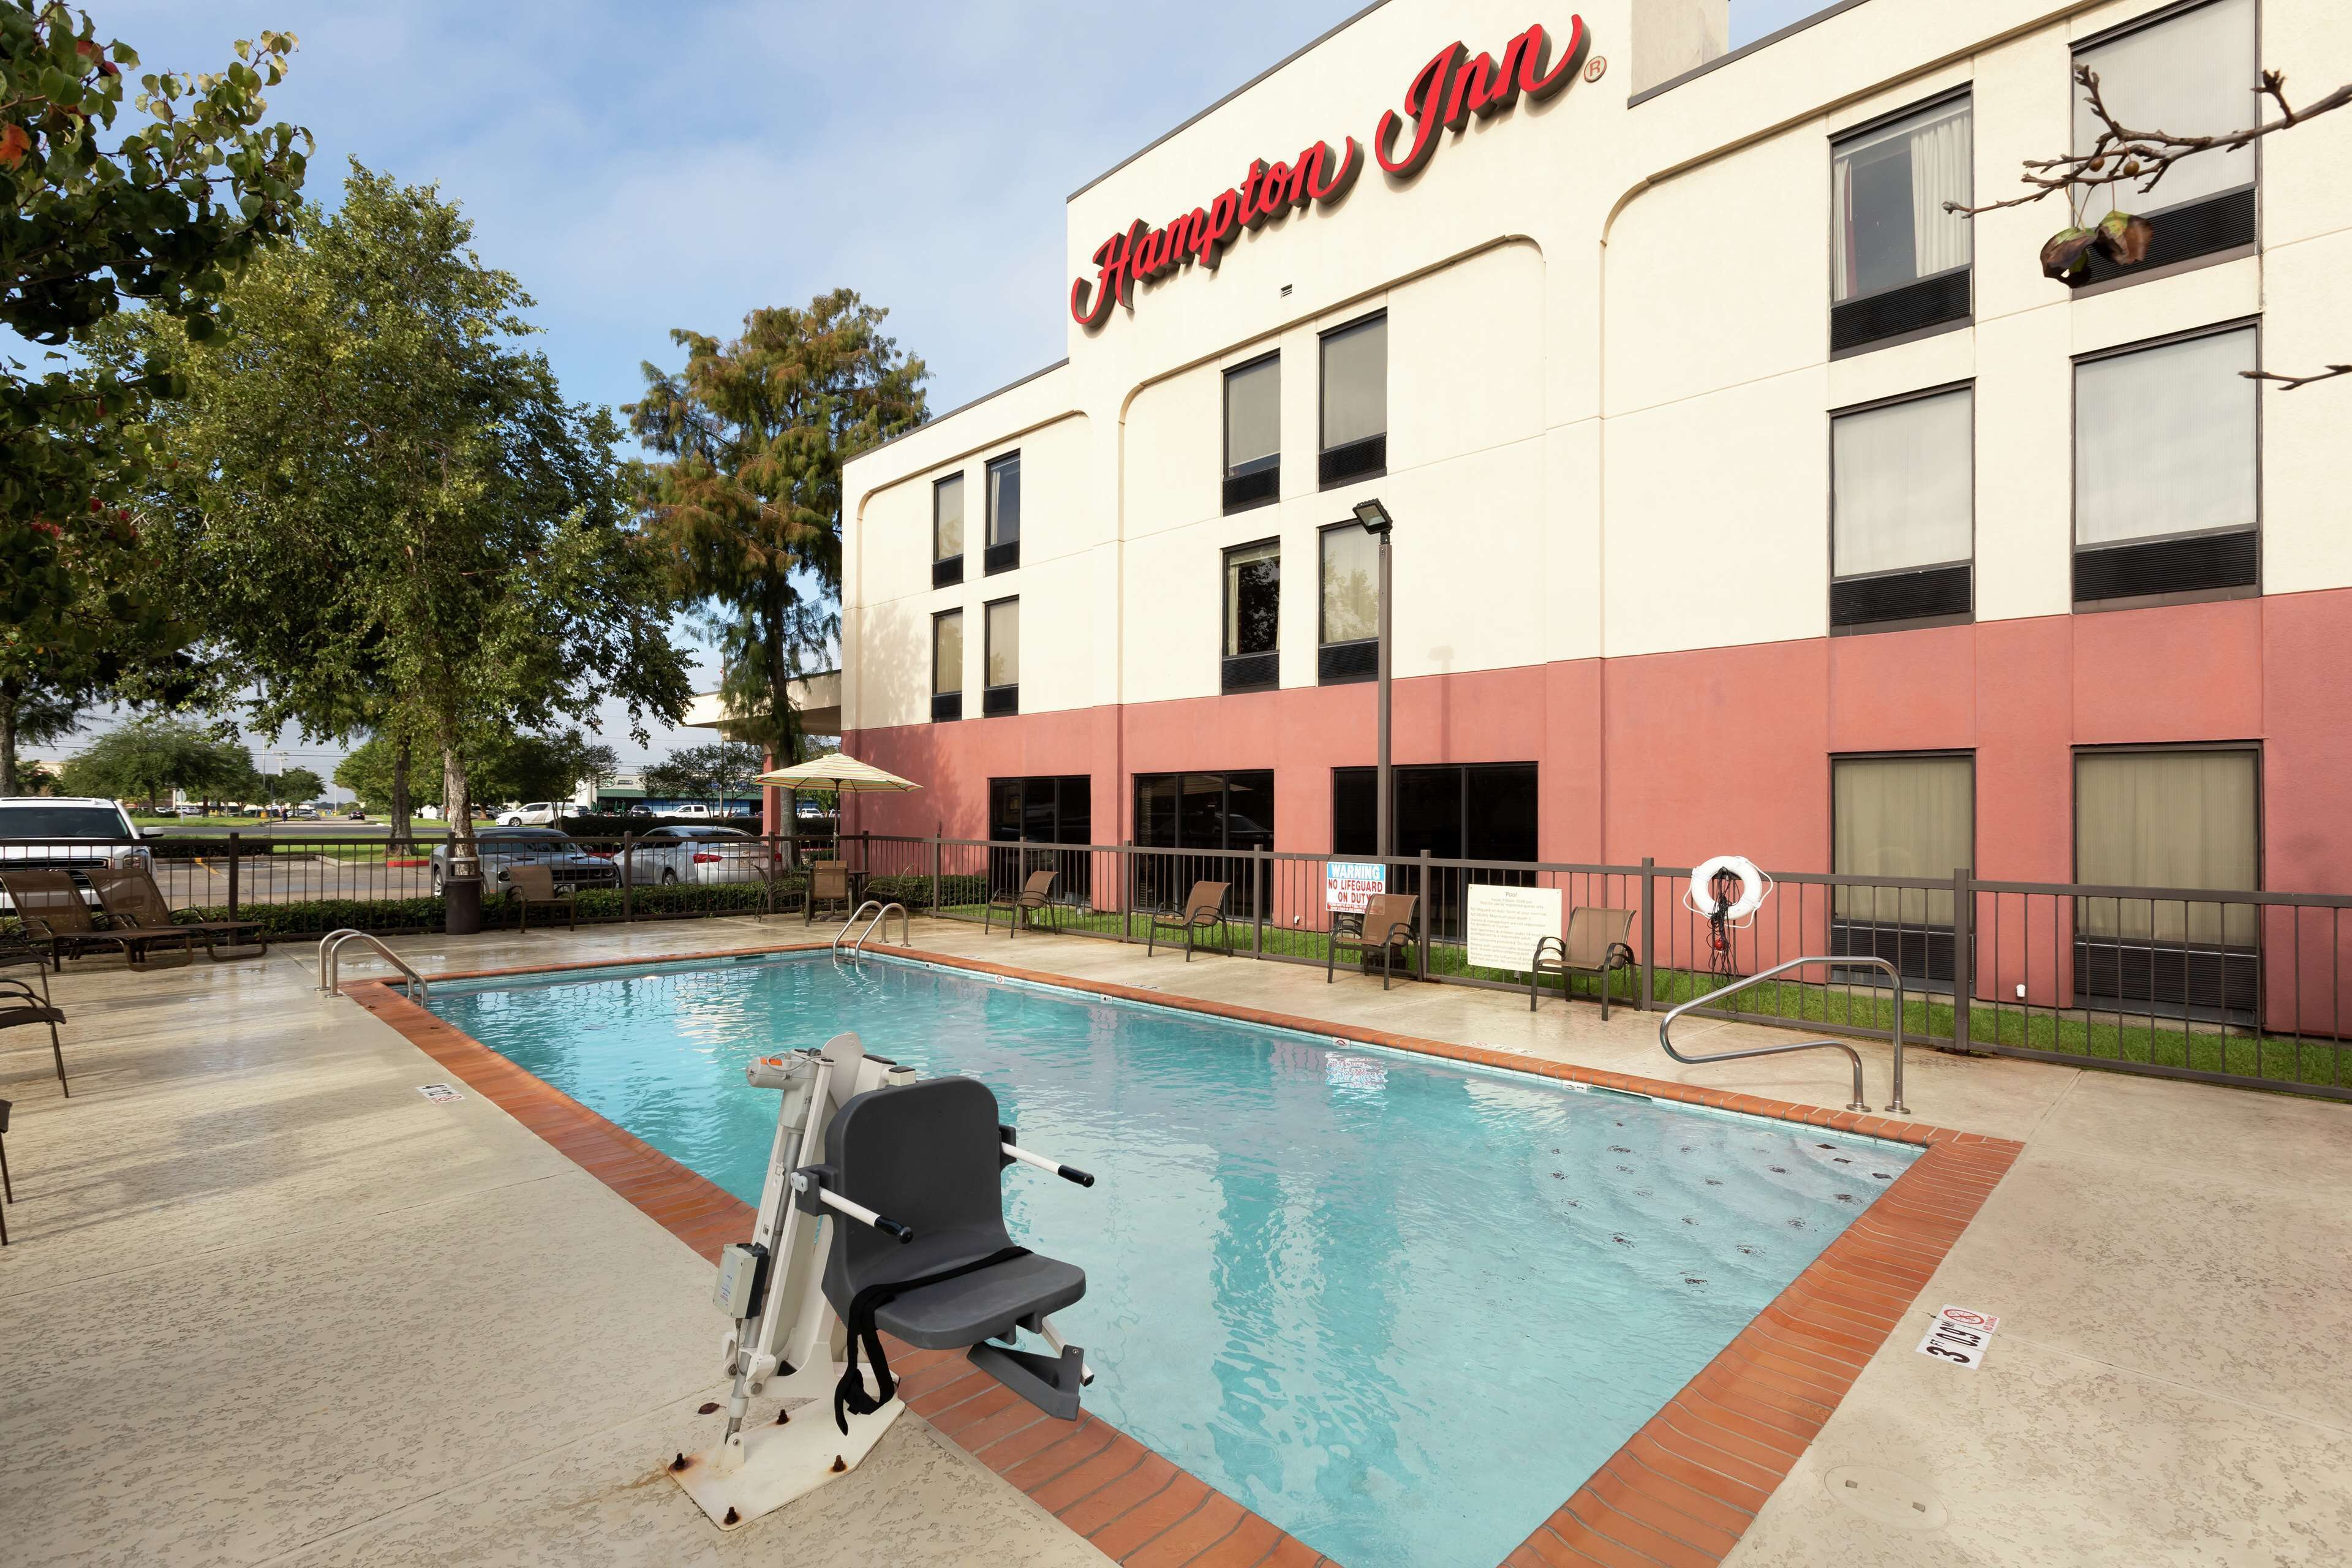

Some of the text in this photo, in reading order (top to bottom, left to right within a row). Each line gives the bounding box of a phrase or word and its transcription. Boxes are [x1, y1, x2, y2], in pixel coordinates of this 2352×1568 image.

[1071, 136, 1355, 325] Hampton
[1374, 14, 1583, 172] Inn
[1331, 864, 1380, 880] WARNING
[1329, 879, 1382, 892] NO LIFEGUARD
[1338, 892, 1371, 903] ON DUTY
